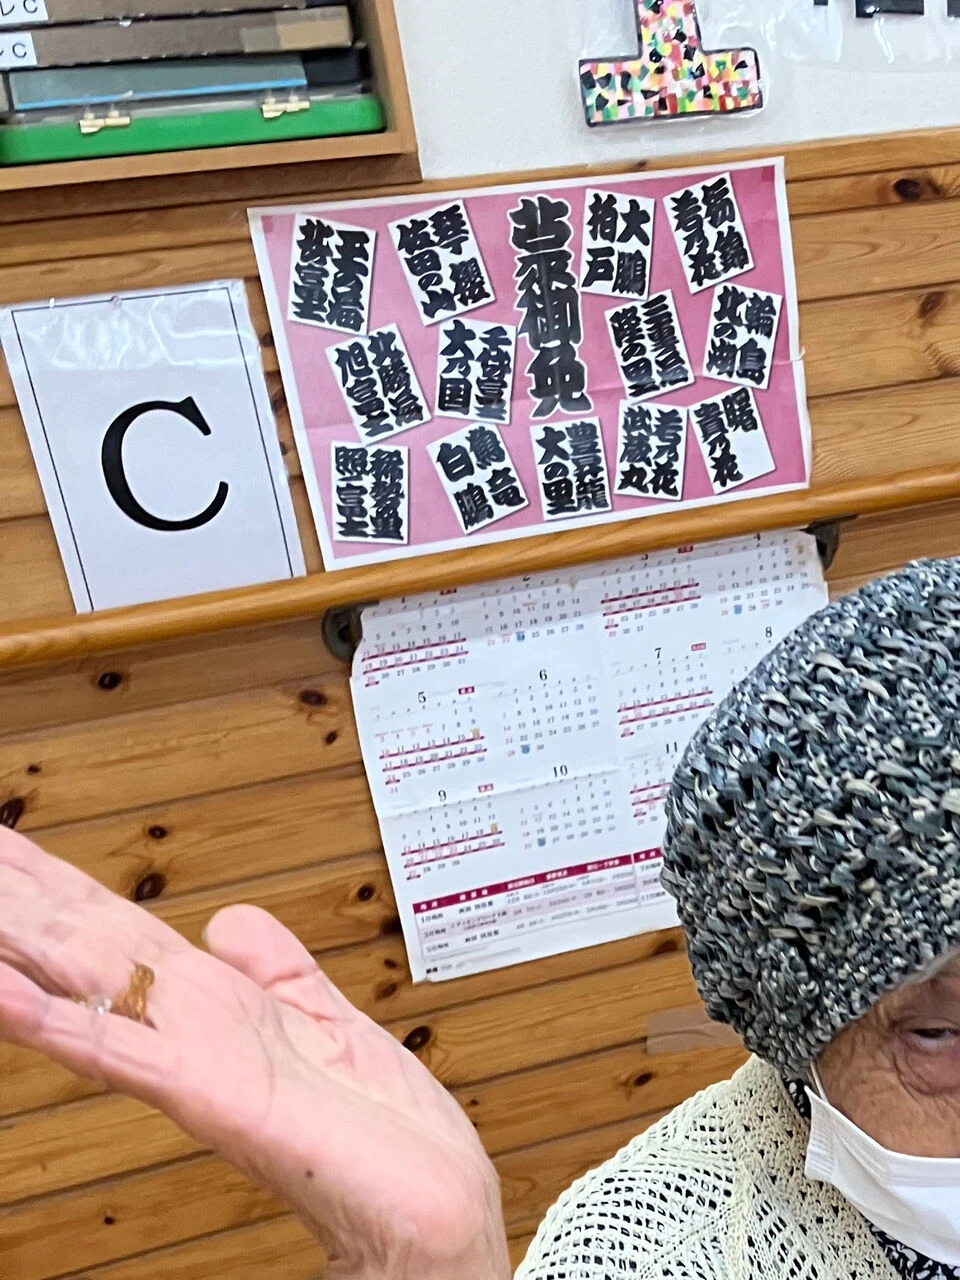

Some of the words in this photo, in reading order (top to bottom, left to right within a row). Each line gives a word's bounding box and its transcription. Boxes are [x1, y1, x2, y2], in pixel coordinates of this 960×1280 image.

[101, 396, 230, 532] C
[765, 626, 772, 638] 8
[654, 647, 661, 658] 7
[539, 669, 548, 681] 6
[417, 691, 426, 703] 5
[666, 741, 678, 754] 11
[553, 764, 568, 778] 10
[438, 789, 447, 802] 9
